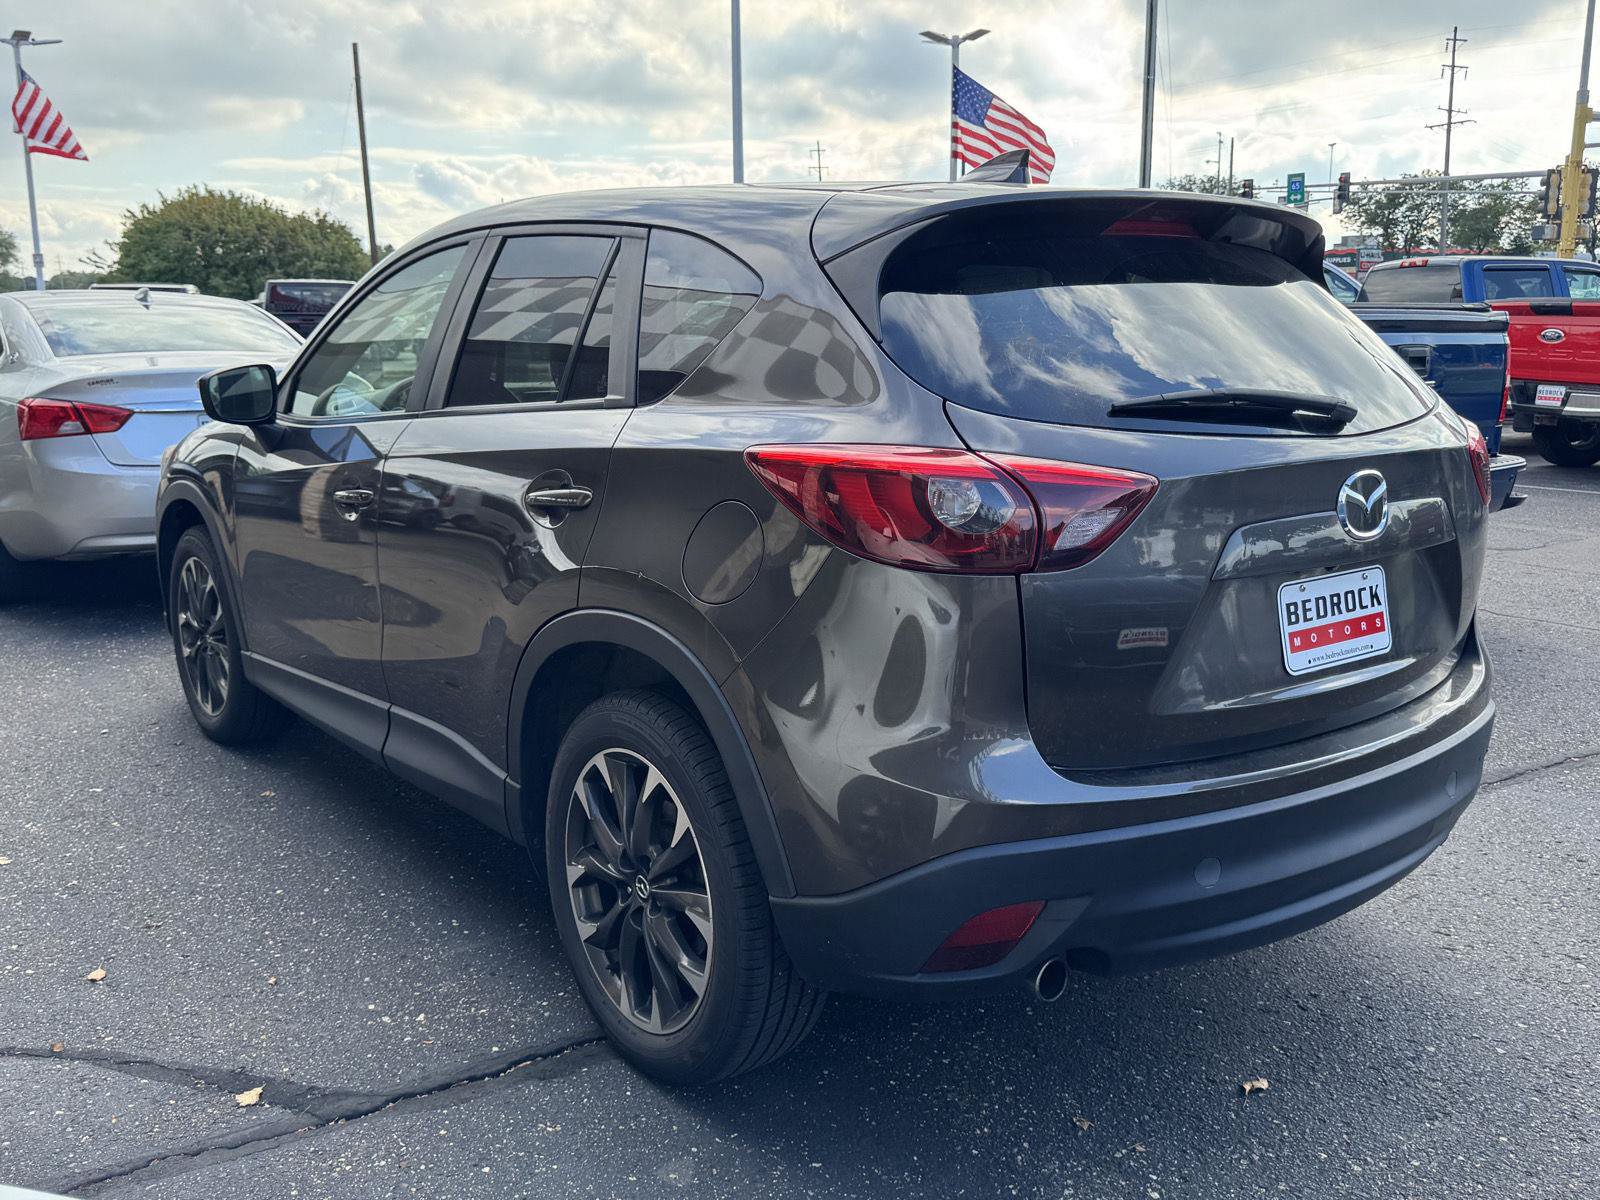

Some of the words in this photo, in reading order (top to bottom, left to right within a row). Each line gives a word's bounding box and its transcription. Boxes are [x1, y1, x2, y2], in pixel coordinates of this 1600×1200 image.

[1291, 182, 1300, 190] 65
[1285, 584, 1382, 626] BEDROCK
[1293, 617, 1381, 646] MOTORS
[1312, 643, 1370, 663] www.bedrockmotors.com
